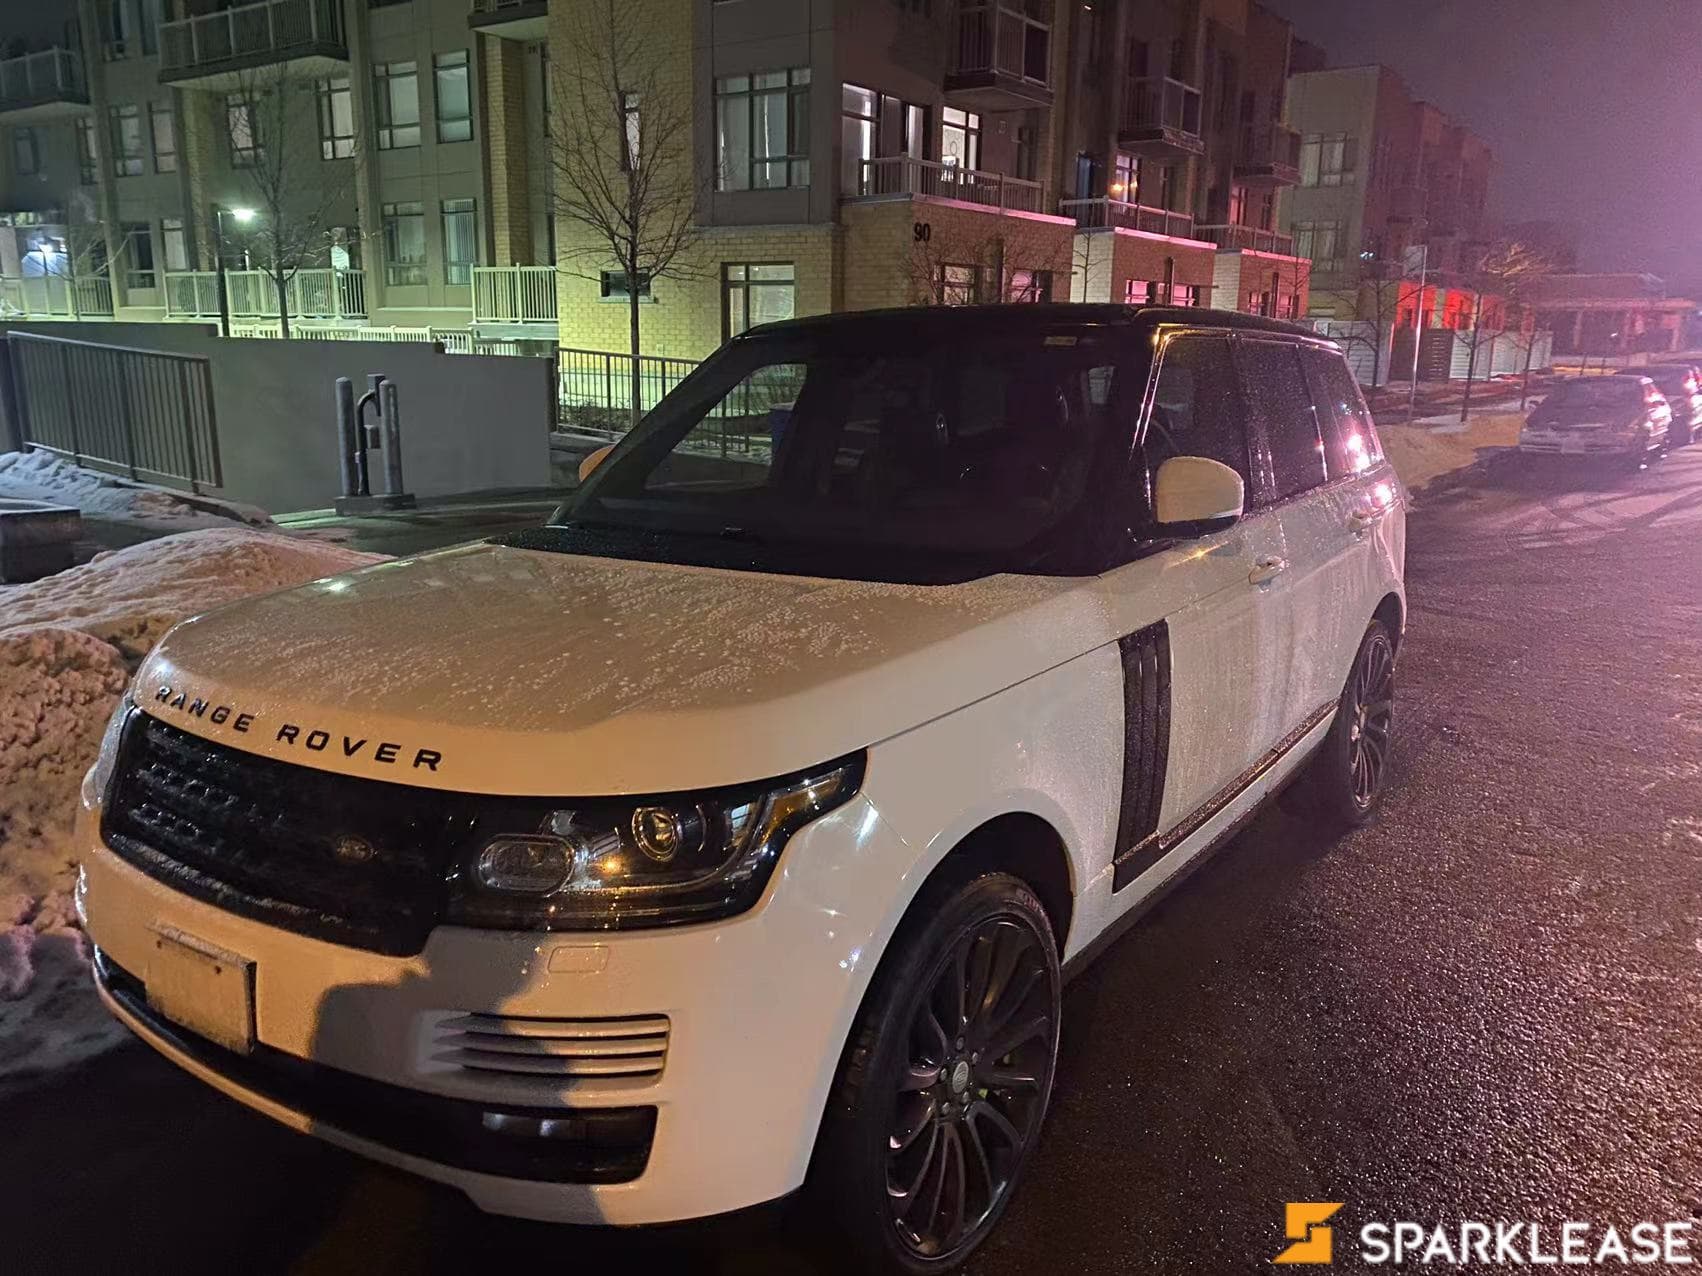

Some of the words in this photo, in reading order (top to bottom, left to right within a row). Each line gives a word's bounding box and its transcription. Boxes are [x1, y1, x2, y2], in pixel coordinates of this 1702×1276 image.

[914, 222, 931, 241] 90
[155, 686, 254, 732] RANGE
[276, 724, 442, 771] ROVER
